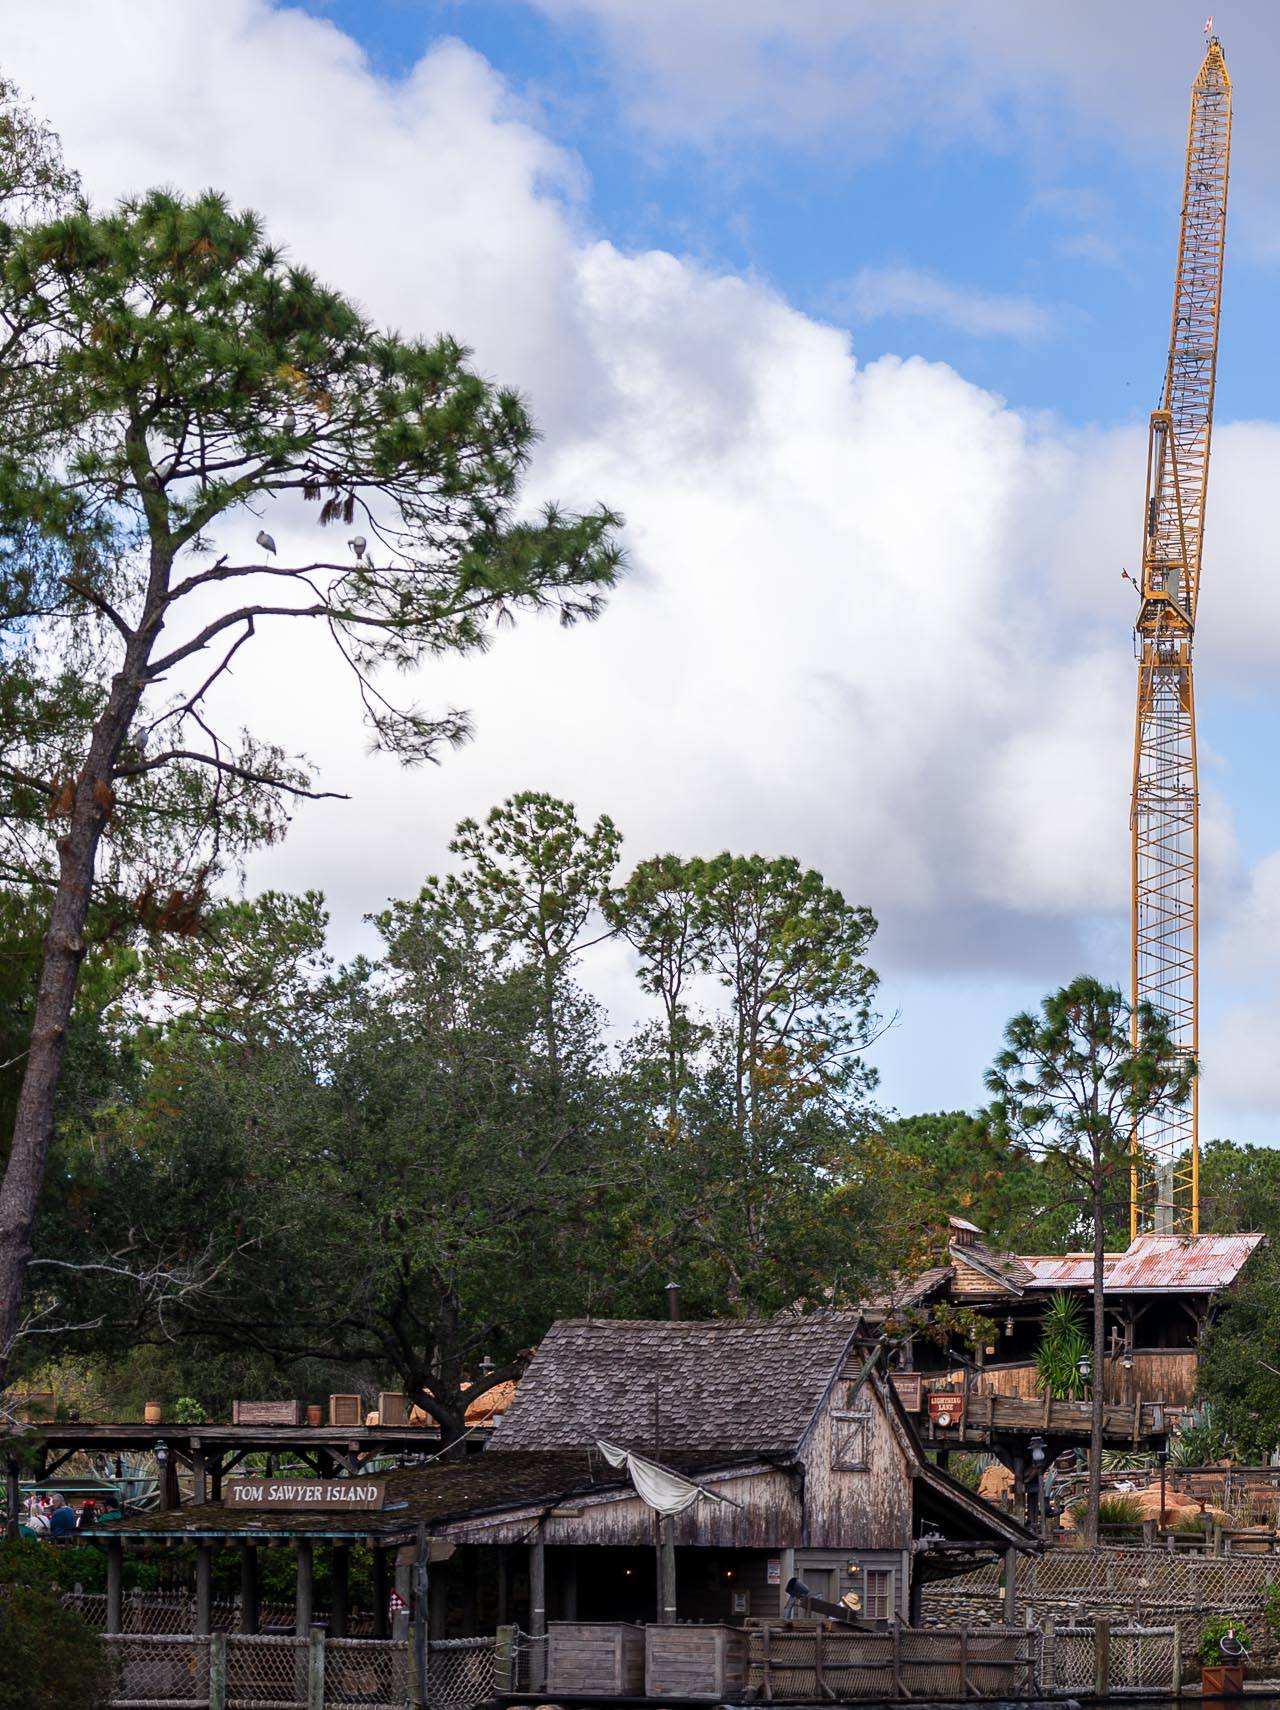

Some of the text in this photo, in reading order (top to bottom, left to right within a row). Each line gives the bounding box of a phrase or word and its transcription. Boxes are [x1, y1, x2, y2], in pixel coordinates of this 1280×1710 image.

[233, 1485, 378, 1501] TOM SAWYER ISLAND
